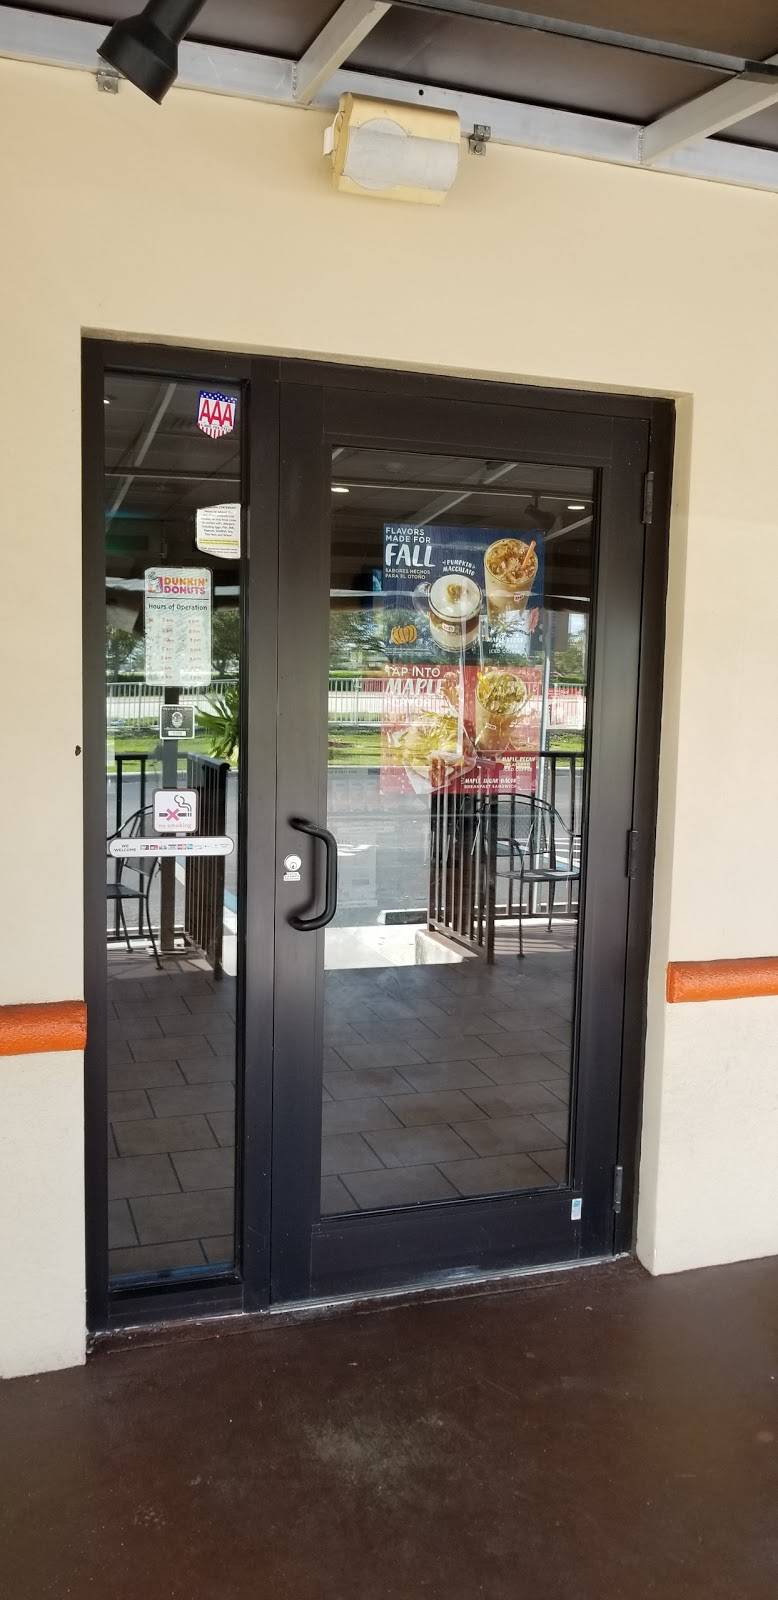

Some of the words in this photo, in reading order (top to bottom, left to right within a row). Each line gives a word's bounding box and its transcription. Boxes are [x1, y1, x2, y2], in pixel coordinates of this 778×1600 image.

[199, 399, 233, 427] AAA
[385, 527, 425, 536] FLAVORS
[385, 535, 411, 543] MADE
[413, 536, 431, 544] FOR
[385, 543, 436, 567] FALL
[446, 559, 473, 569] PUMPKIN
[164, 586, 206, 595] DONUTS
[168, 603, 175, 611] of
[385, 665, 409, 677] TAP
[412, 666, 441, 678] INTO
[385, 678, 447, 698] MAPLE
